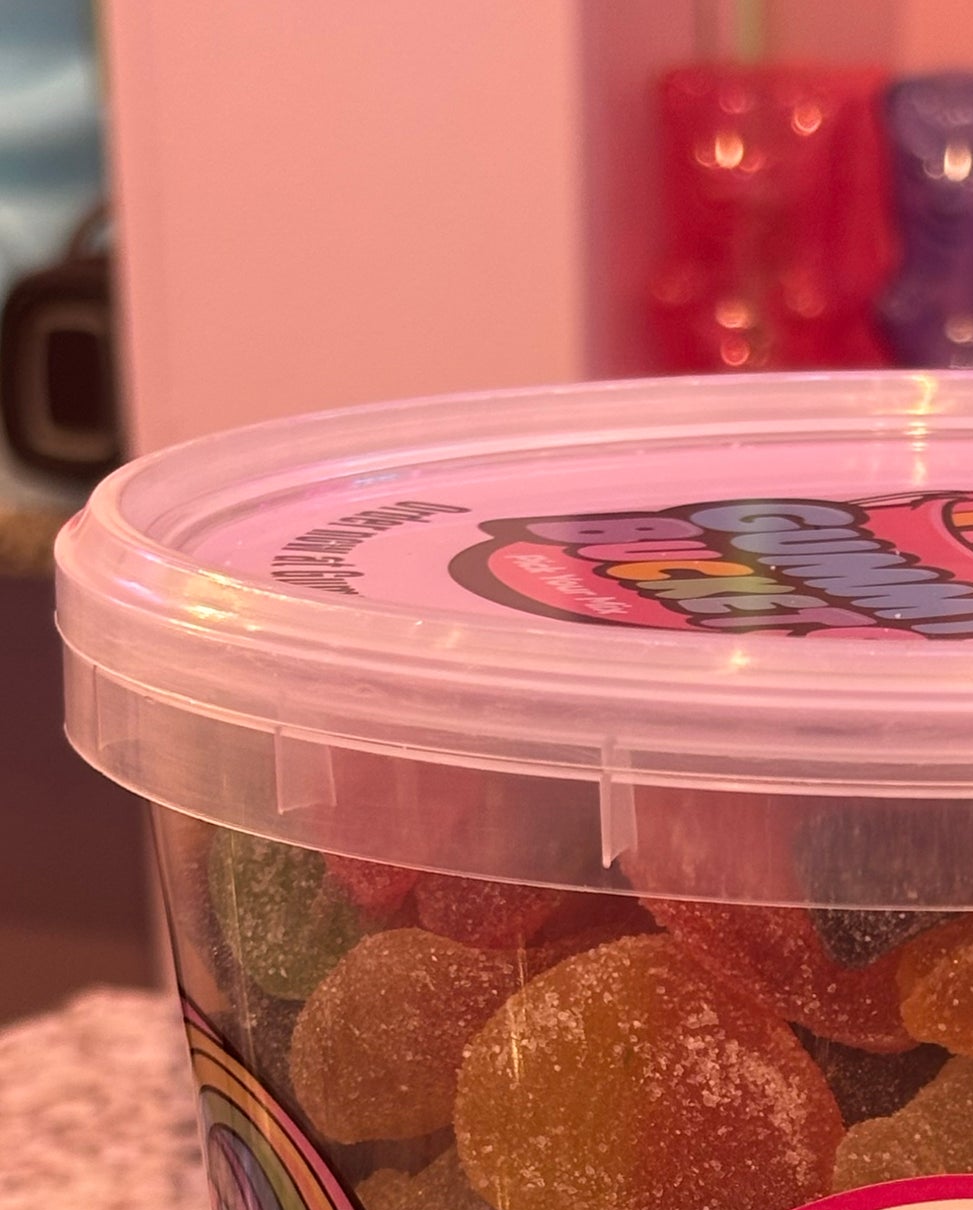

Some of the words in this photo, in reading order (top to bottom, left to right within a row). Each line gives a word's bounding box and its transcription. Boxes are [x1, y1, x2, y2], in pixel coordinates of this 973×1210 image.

[328, 500, 471, 531] Order
[281, 529, 377, 554] now
[271, 555, 355, 568] at
